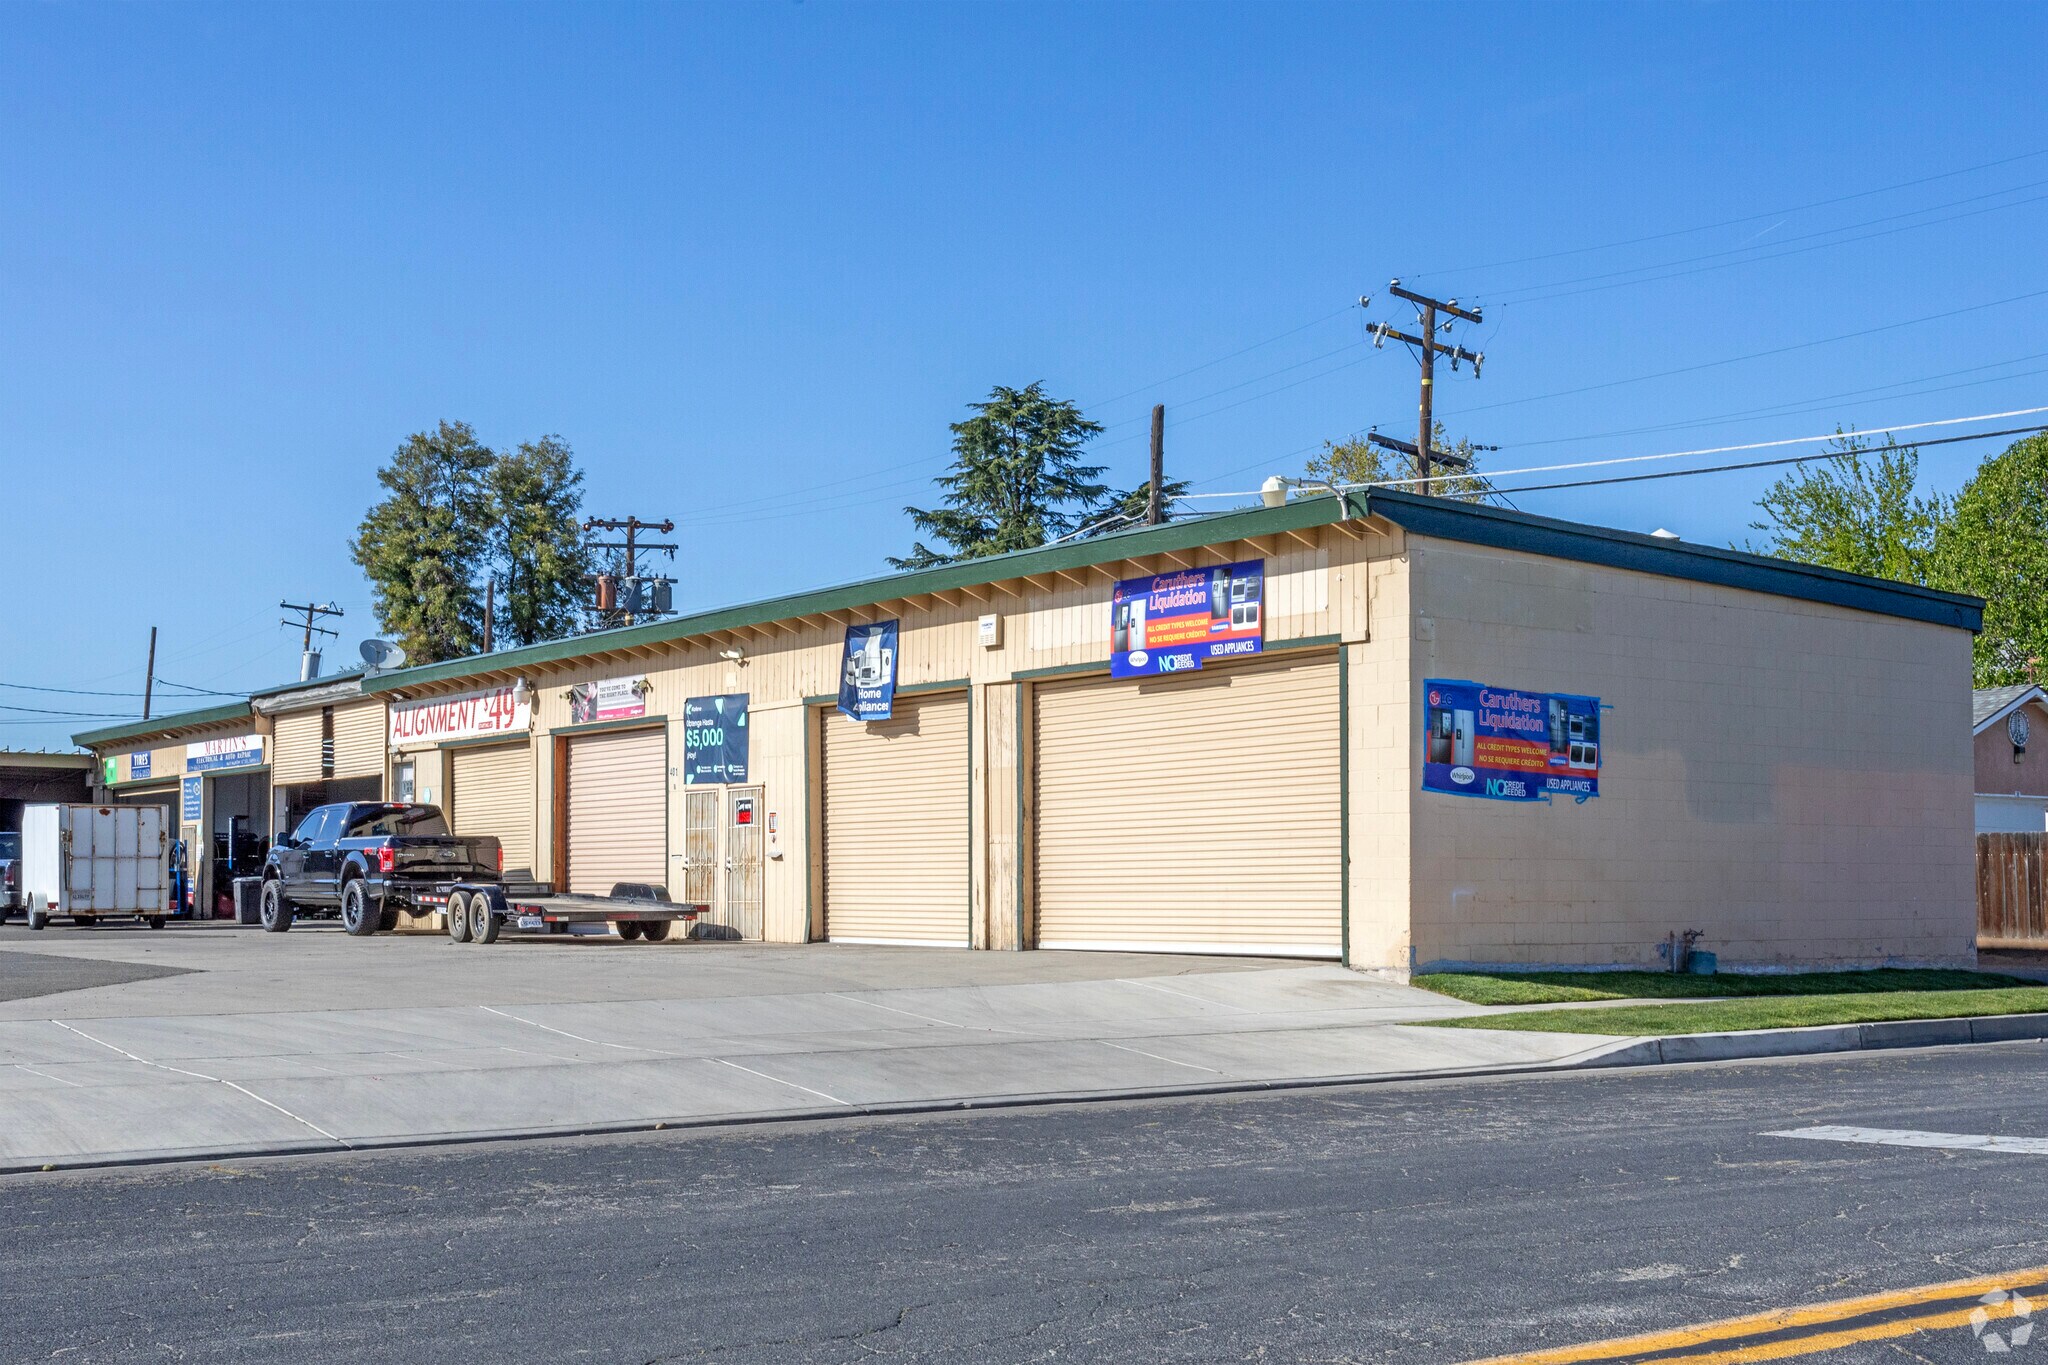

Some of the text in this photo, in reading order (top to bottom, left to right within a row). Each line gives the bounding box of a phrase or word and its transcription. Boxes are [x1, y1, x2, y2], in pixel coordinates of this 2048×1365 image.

[1152, 572, 1205, 593] Caruthers
[1150, 589, 1206, 613] Liquidation
[1156, 624, 1170, 632] CREDIT
[1172, 621, 1185, 630] TYPES
[1186, 618, 1208, 628] WELCOME
[1164, 633, 1185, 642] REQUIERE
[1210, 640, 1254, 656] USED APPLIANCES
[1158, 655, 1176, 672] NO
[858, 689, 881, 699] Home
[1441, 694, 1452, 705] LG
[1480, 690, 1540, 713] Caruthers
[393, 697, 480, 738] ALIGNMENT
[1479, 709, 1544, 732] Liquidation
[205, 736, 246, 755] MARTIN'S
[686, 728, 723, 750] $5,000
[1487, 743, 1504, 752] CREDIT
[1505, 745, 1520, 754] TYPES
[1521, 746, 1547, 756] WELCOME
[134, 753, 148, 766] TIRES
[1495, 757, 1520, 766] REQUIERE
[1520, 757, 1544, 767] CRÉDITO
[1452, 772, 1474, 781] Whirlpool
[1486, 778, 1506, 796] NO
[1504, 780, 1525, 790] CREDIT
[1546, 778, 1590, 792] USED APPLIANCES
